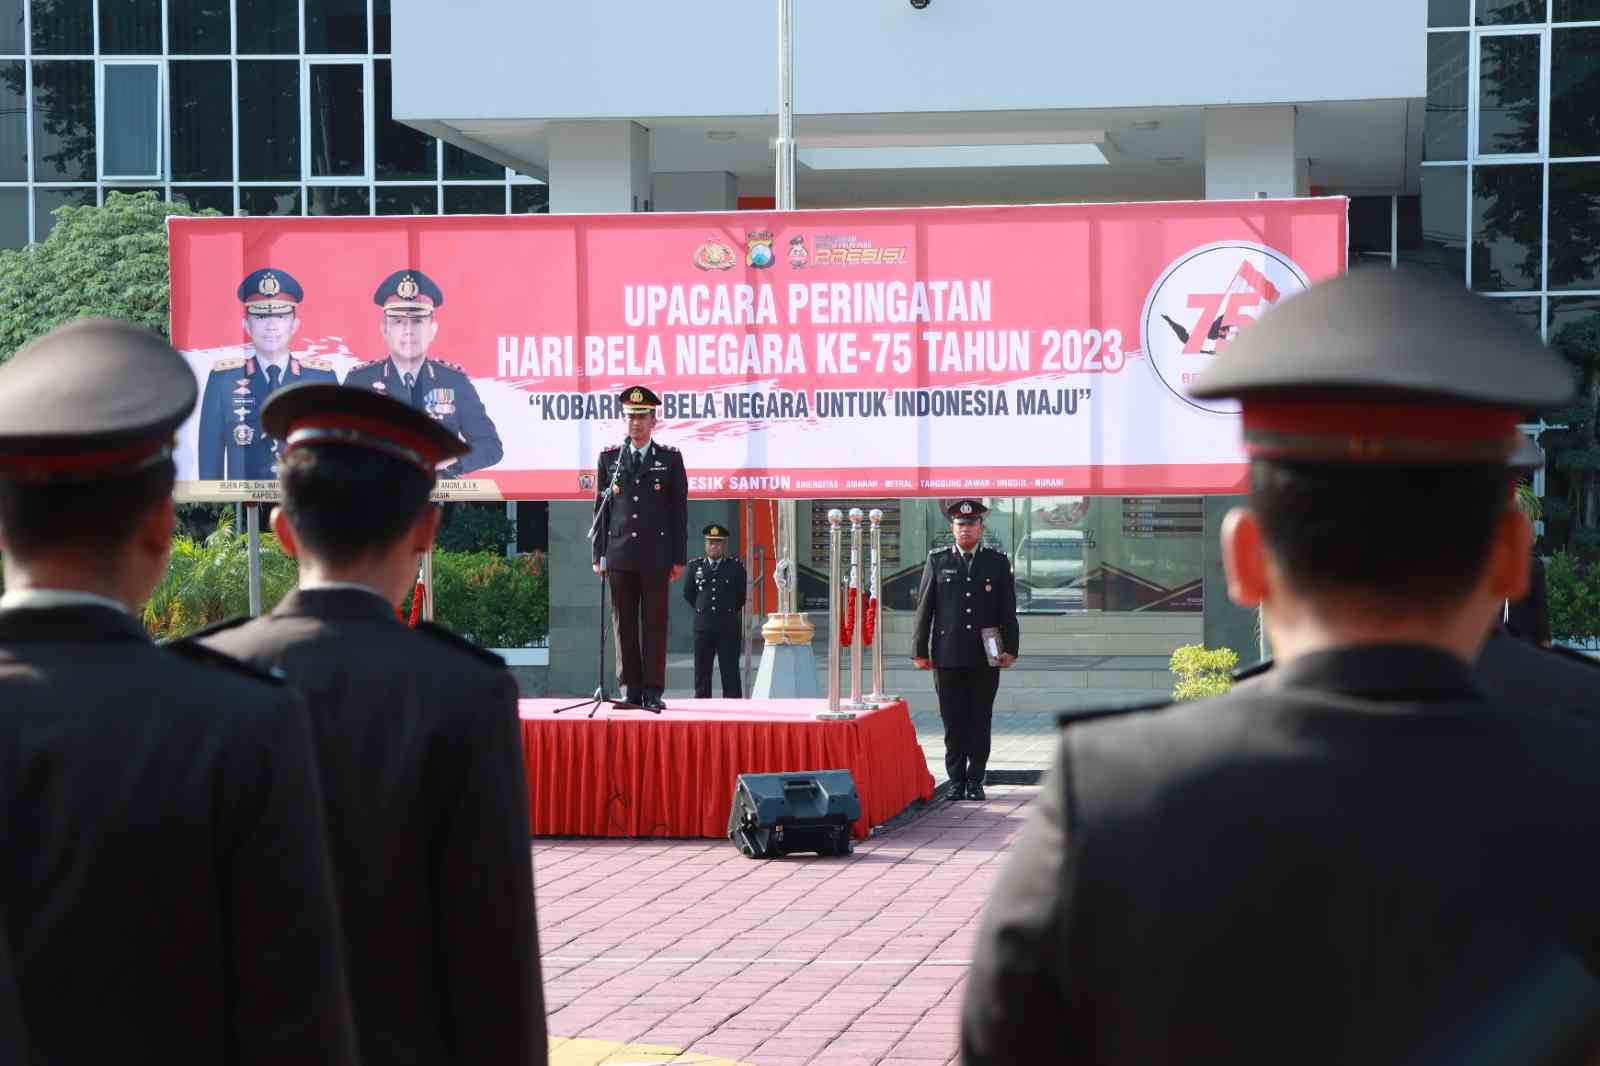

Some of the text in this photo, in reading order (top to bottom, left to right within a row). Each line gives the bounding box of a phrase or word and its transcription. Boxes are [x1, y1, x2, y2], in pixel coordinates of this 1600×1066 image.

[815, 247, 906, 261] PRESISI
[624, 280, 992, 327] UPACARA PERINGATAN
[497, 328, 1125, 377] HARI BELA NEGARA KE-75 TAHUN 2023
[528, 388, 1092, 421] “KOBARK BELA NEGARA UNTUK INDONESIA MAJU”
[687, 475, 724, 491] ESIK
[728, 475, 791, 490] SANTUN
